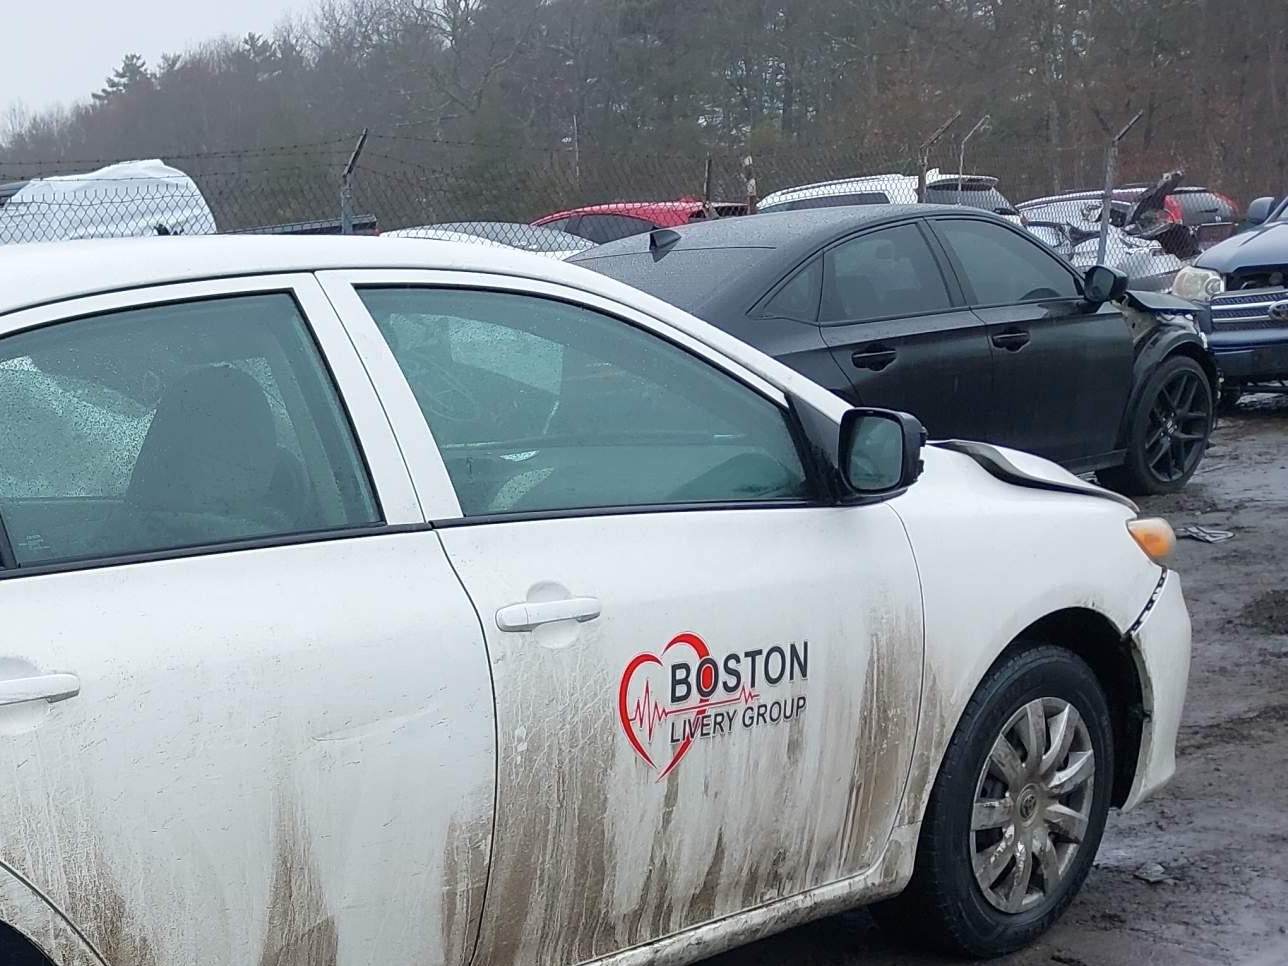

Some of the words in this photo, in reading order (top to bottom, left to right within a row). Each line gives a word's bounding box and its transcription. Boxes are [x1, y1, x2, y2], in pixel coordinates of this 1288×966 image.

[670, 640, 809, 704] BOSTON
[670, 708, 738, 744] LIVERY
[741, 695, 808, 729] GROUP
